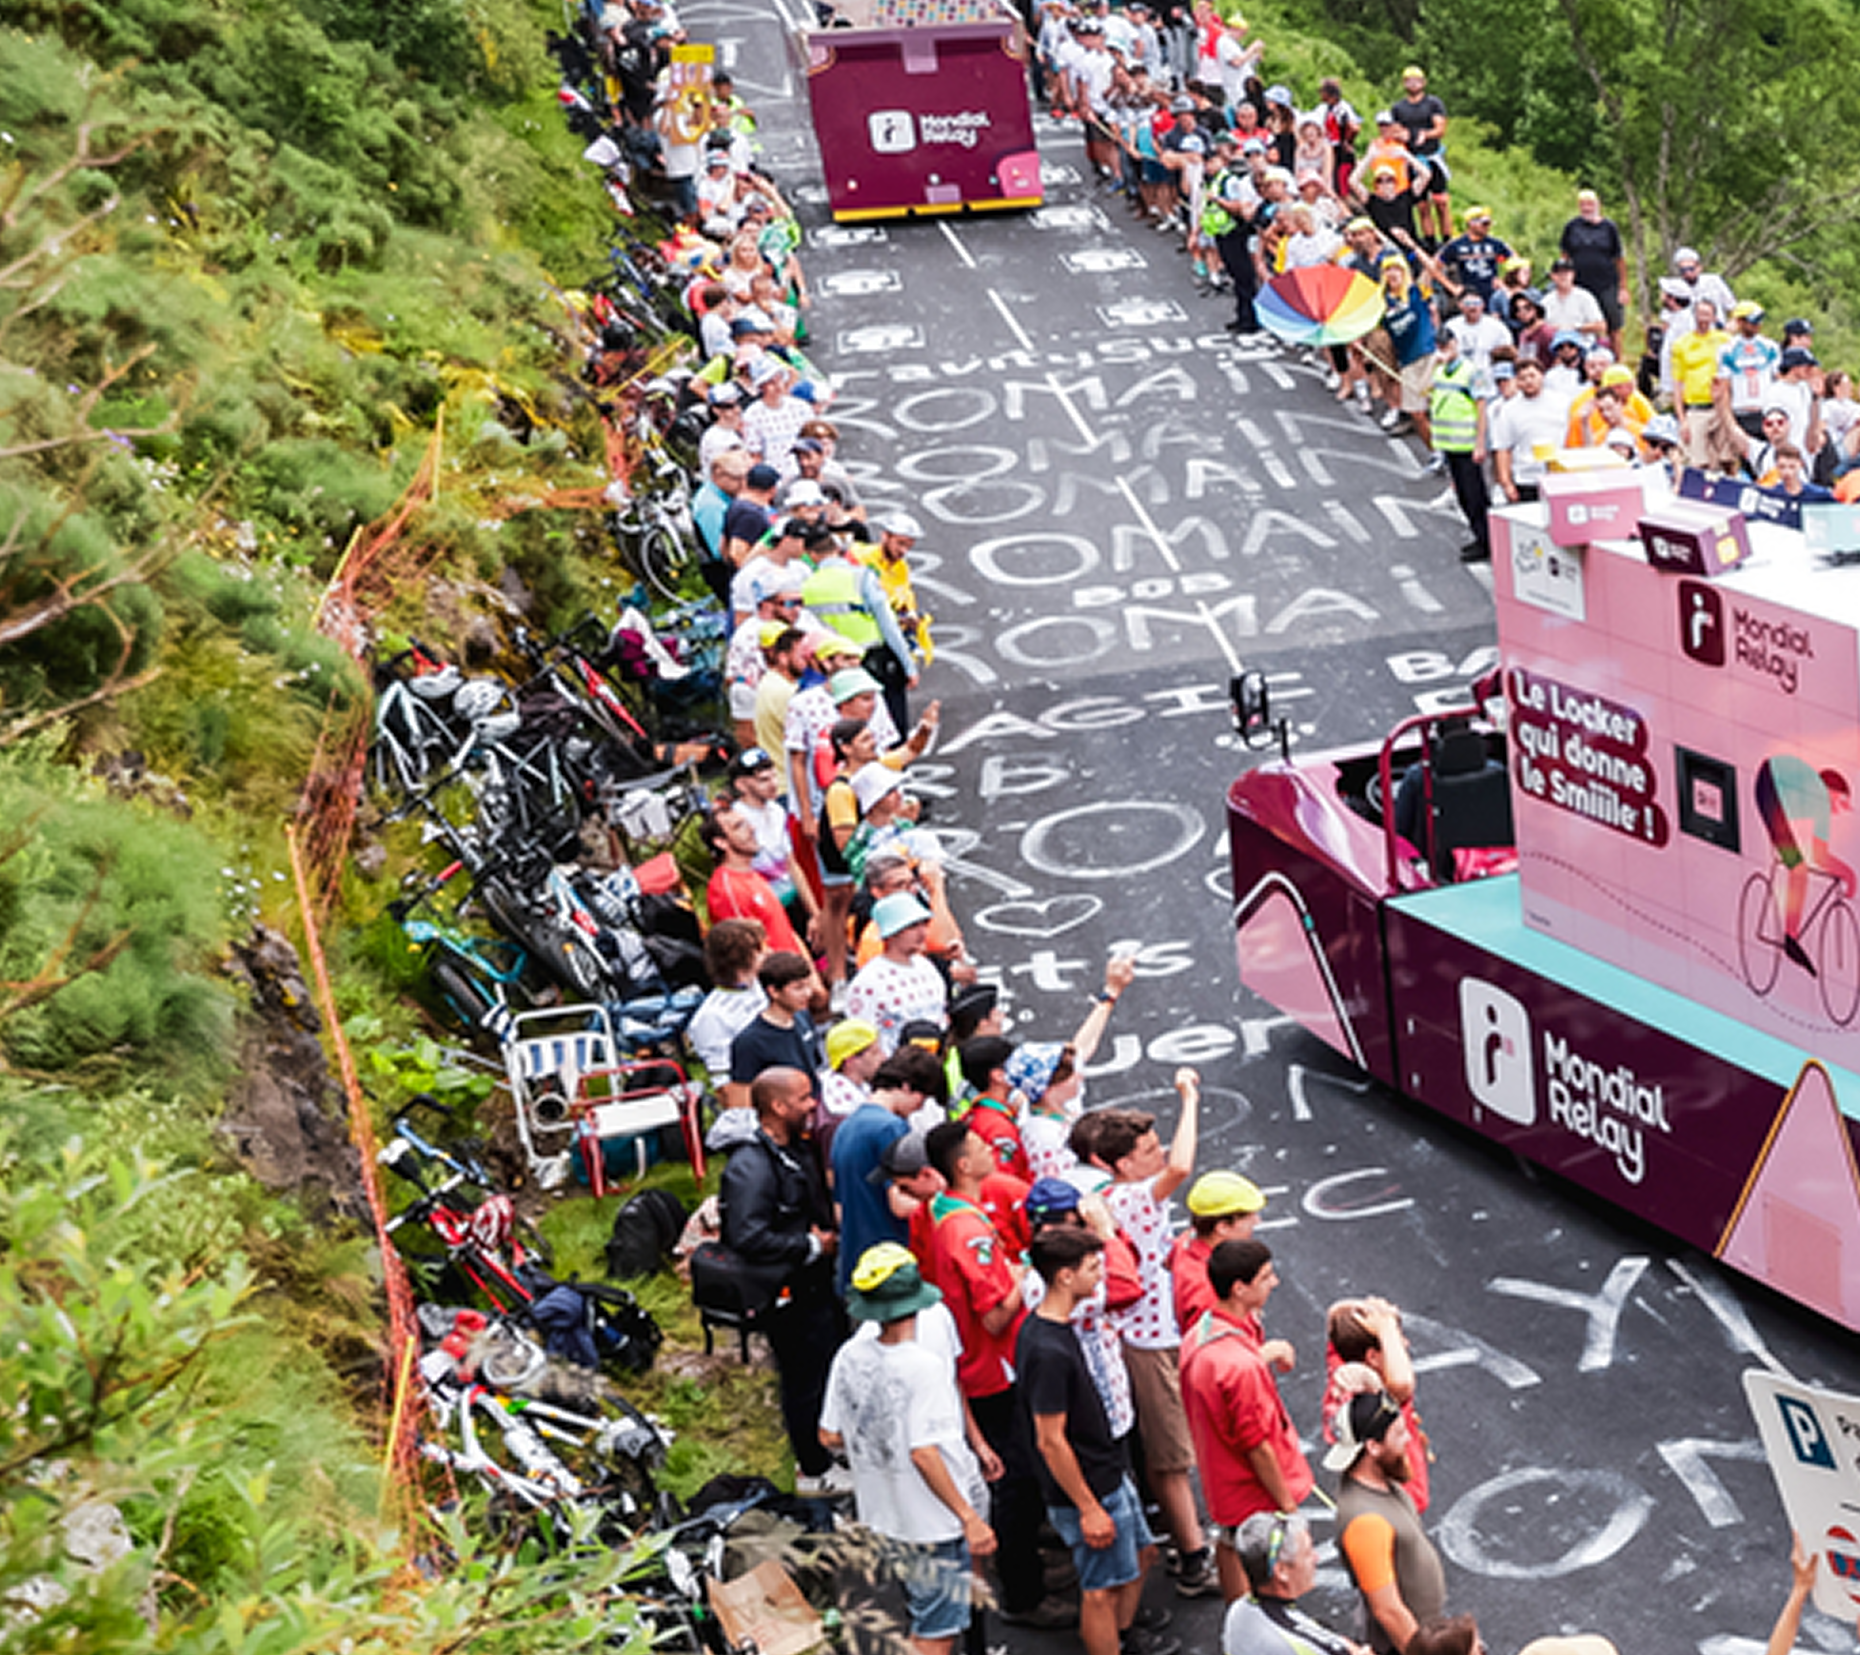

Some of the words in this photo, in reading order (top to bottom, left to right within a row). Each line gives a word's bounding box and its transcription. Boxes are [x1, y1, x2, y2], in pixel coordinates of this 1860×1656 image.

[919, 112, 991, 131] Mondial
[1732, 607, 1815, 659] Mondial
[1735, 635, 1798, 695] Relay
[1513, 669, 1546, 711] Le
[1550, 684, 1638, 746] Locker
[1518, 721, 1560, 759] qui
[1564, 733, 1647, 794] donne
[1543, 1029, 1672, 1133] Mondial
[1549, 1077, 1645, 1184] Relay
